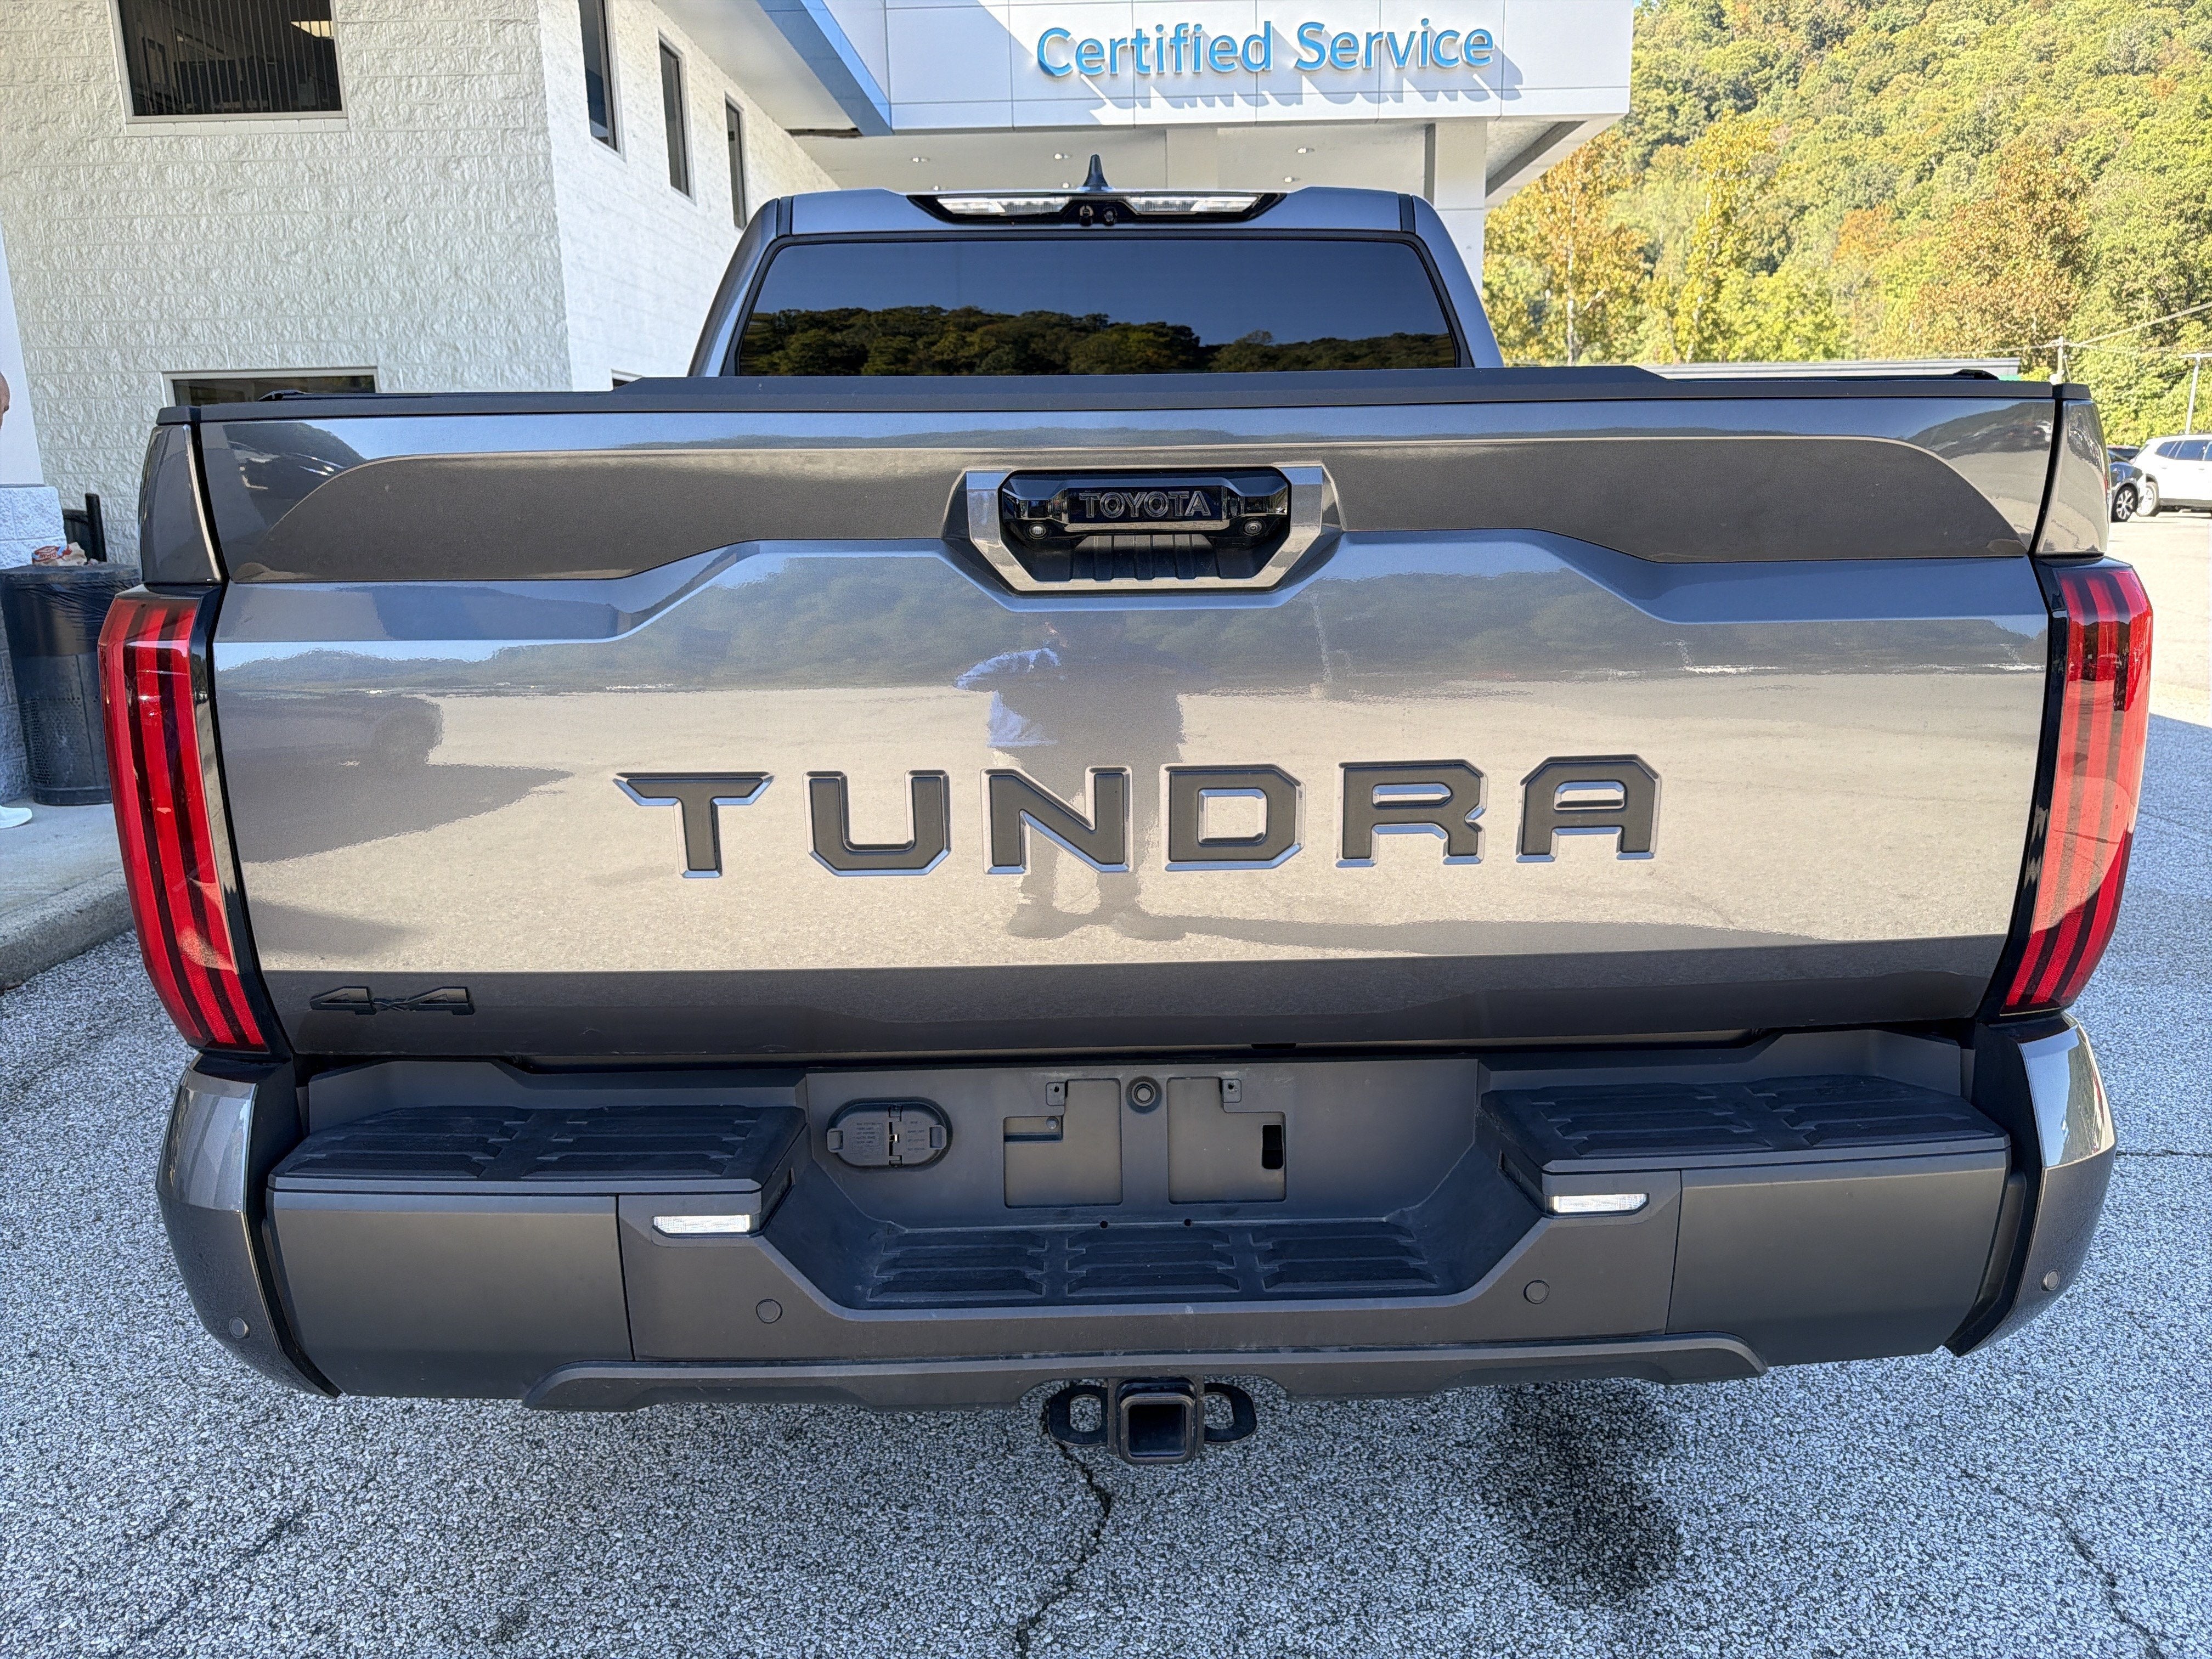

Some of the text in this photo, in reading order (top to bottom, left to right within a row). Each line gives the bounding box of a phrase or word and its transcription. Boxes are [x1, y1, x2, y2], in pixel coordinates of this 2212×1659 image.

[1037, 18, 1494, 75] Certified Service
[1079, 491, 1211, 518] TOYOTA
[614, 755, 1661, 878] TUNDRA
